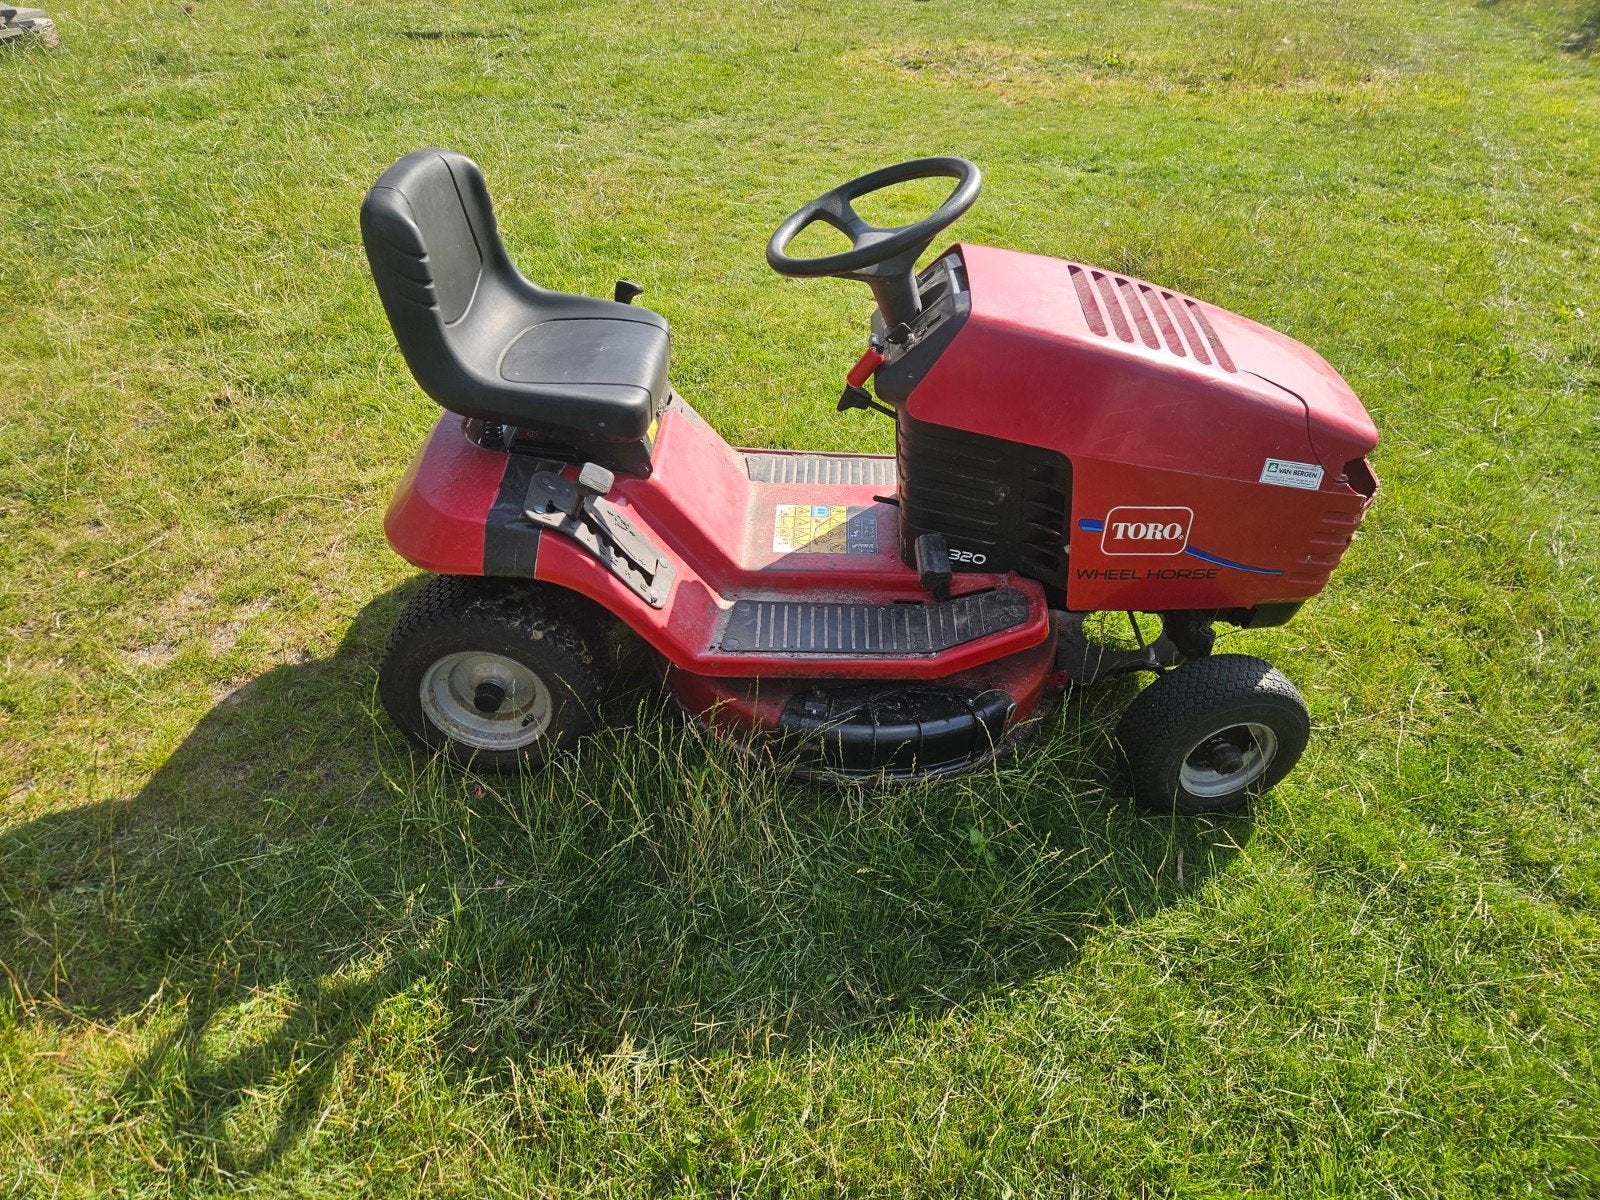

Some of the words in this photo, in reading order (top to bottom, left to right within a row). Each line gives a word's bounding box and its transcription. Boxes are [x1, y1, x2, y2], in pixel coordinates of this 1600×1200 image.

[1279, 467, 1292, 475] VAN
[1292, 469, 1318, 478] BERGEN
[1112, 522, 1183, 540] TORO
[1076, 569, 1142, 580] WHEEL
[1146, 568, 1220, 580] HORSE
